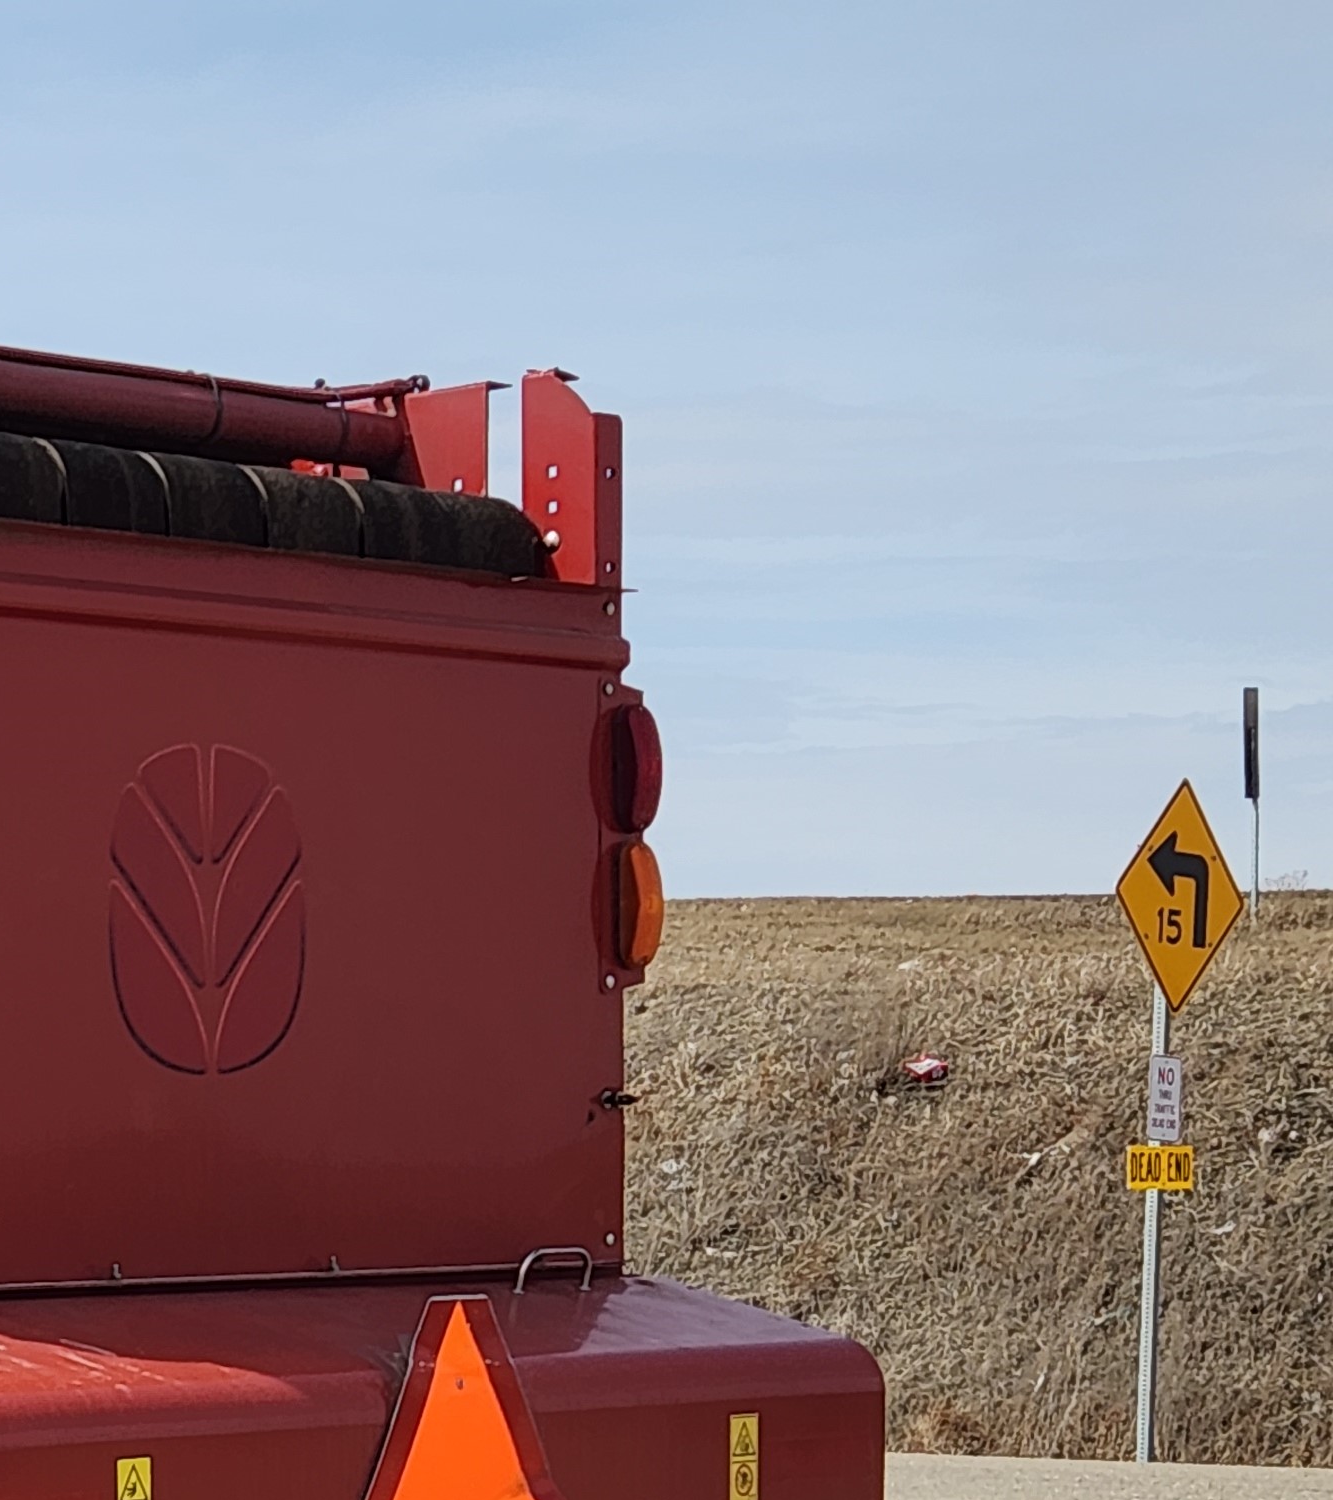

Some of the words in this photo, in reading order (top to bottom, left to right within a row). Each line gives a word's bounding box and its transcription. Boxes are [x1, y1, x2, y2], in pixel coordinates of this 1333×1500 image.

[1157, 906, 1183, 946] 15
[1157, 1066, 1175, 1086] NO
[1130, 1151, 1161, 1183] DEAD
[1167, 1151, 1191, 1183] END
